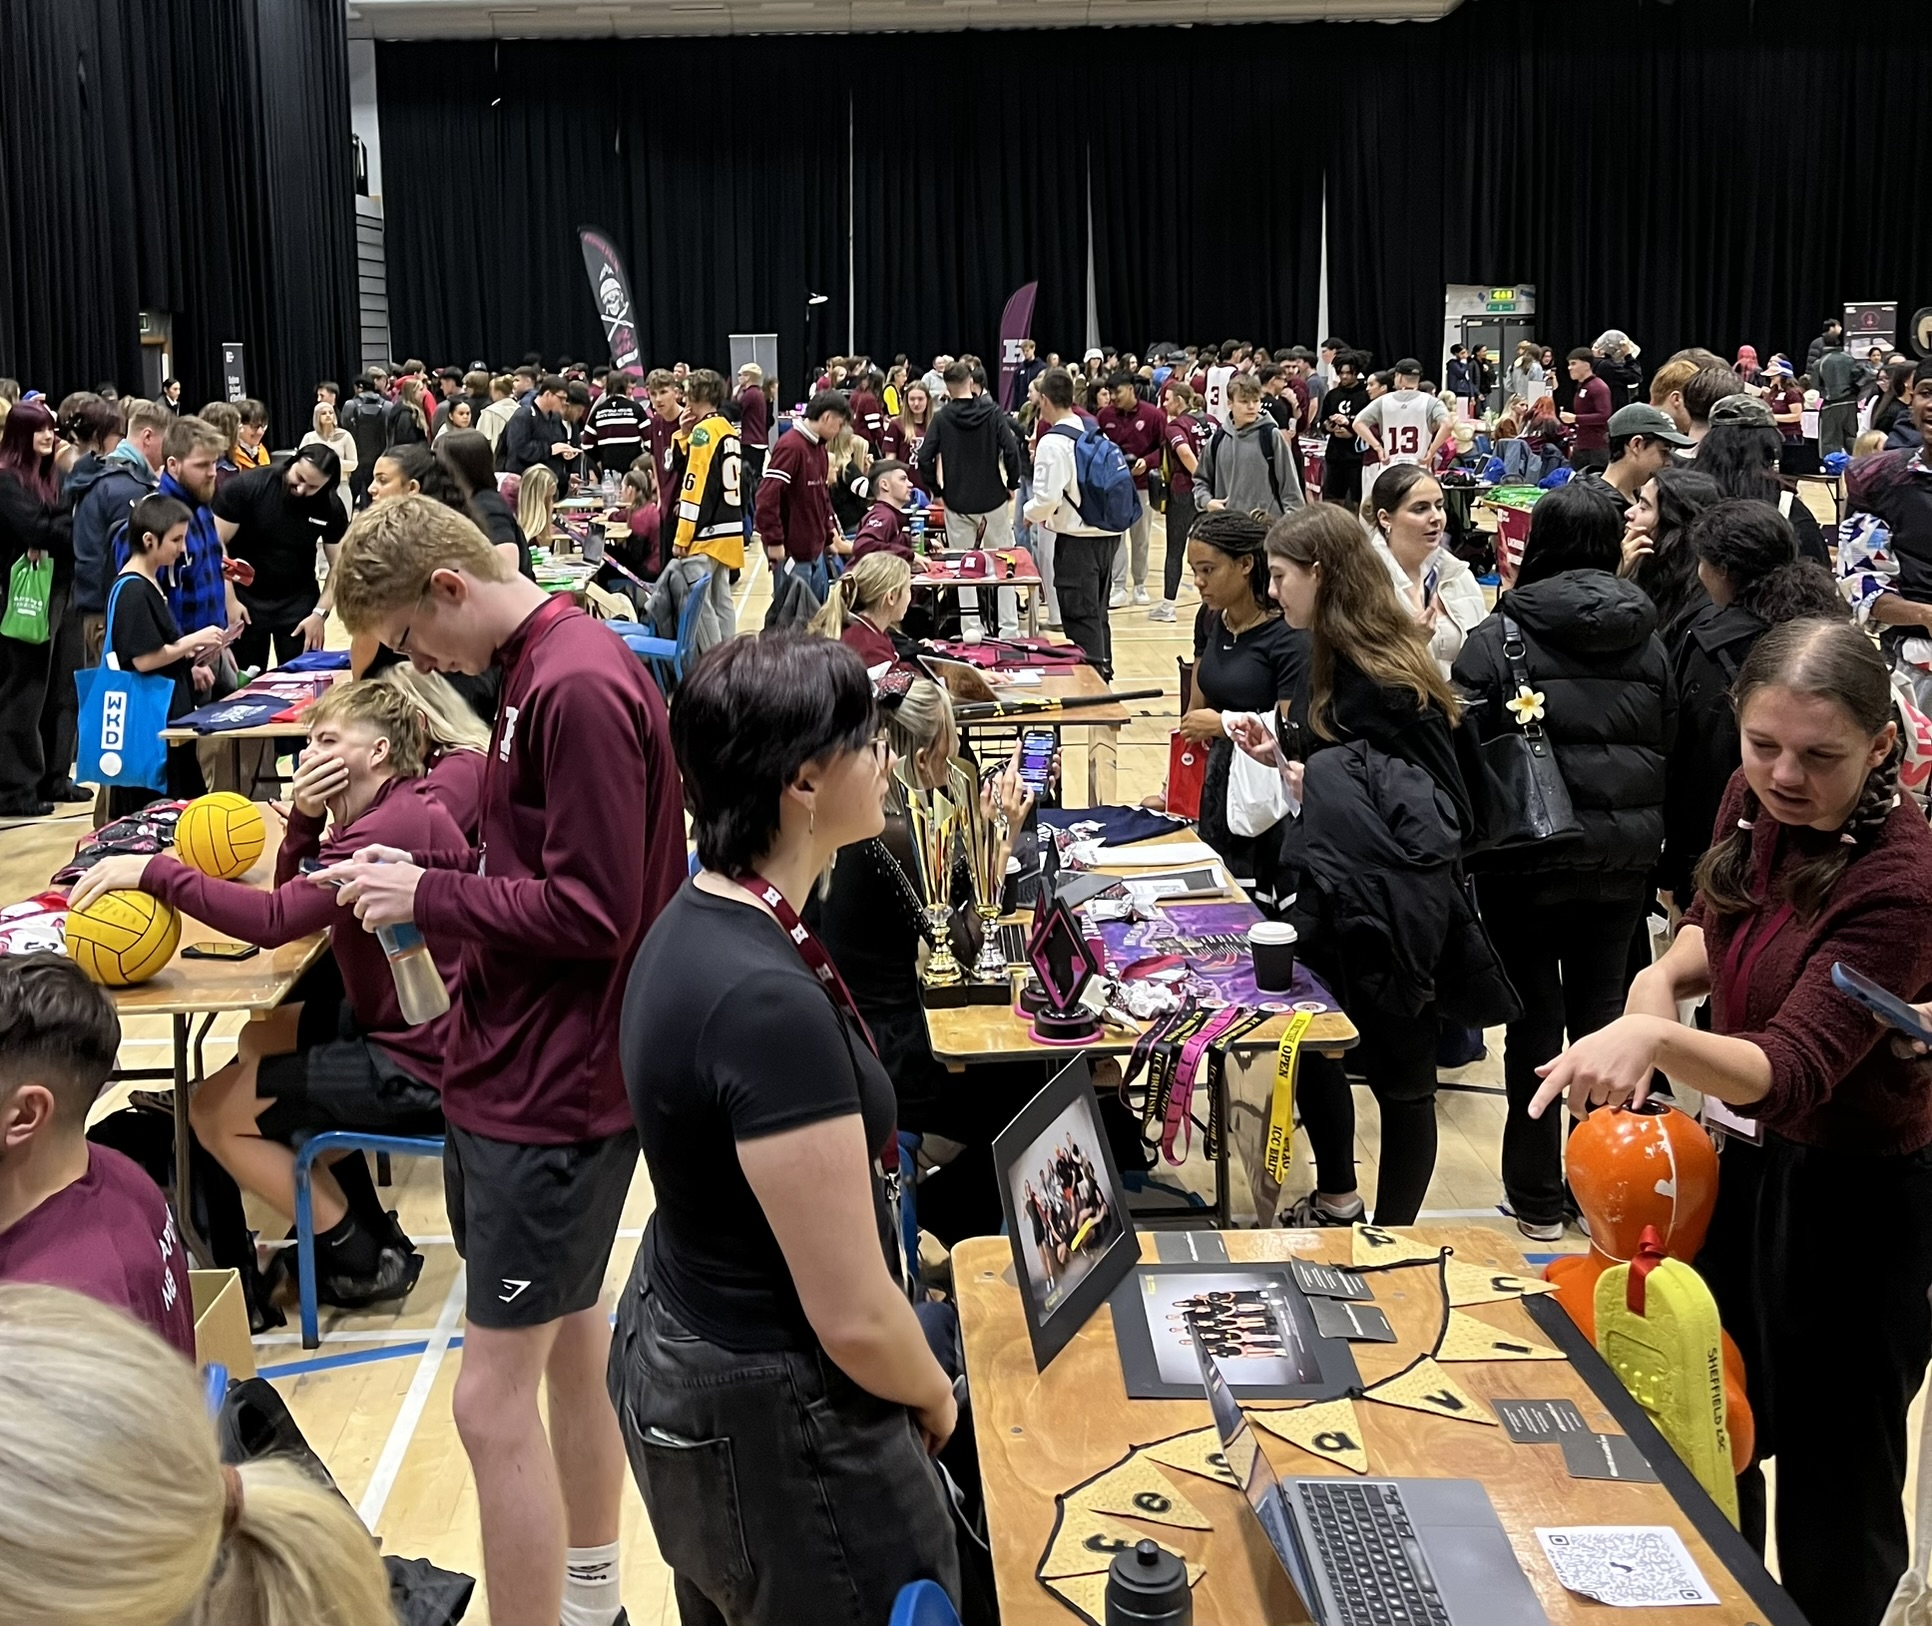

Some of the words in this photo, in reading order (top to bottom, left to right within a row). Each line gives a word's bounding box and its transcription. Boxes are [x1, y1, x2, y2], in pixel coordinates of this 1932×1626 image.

[1389, 426, 1418, 455] 13
[105, 695, 122, 745] WKD
[1153, 1052, 1163, 1072] ICC
[1279, 1046, 1292, 1079] OPEN
[1271, 1124, 1282, 1146] ICC
[1707, 1347, 1722, 1425] SHEFFIELD
